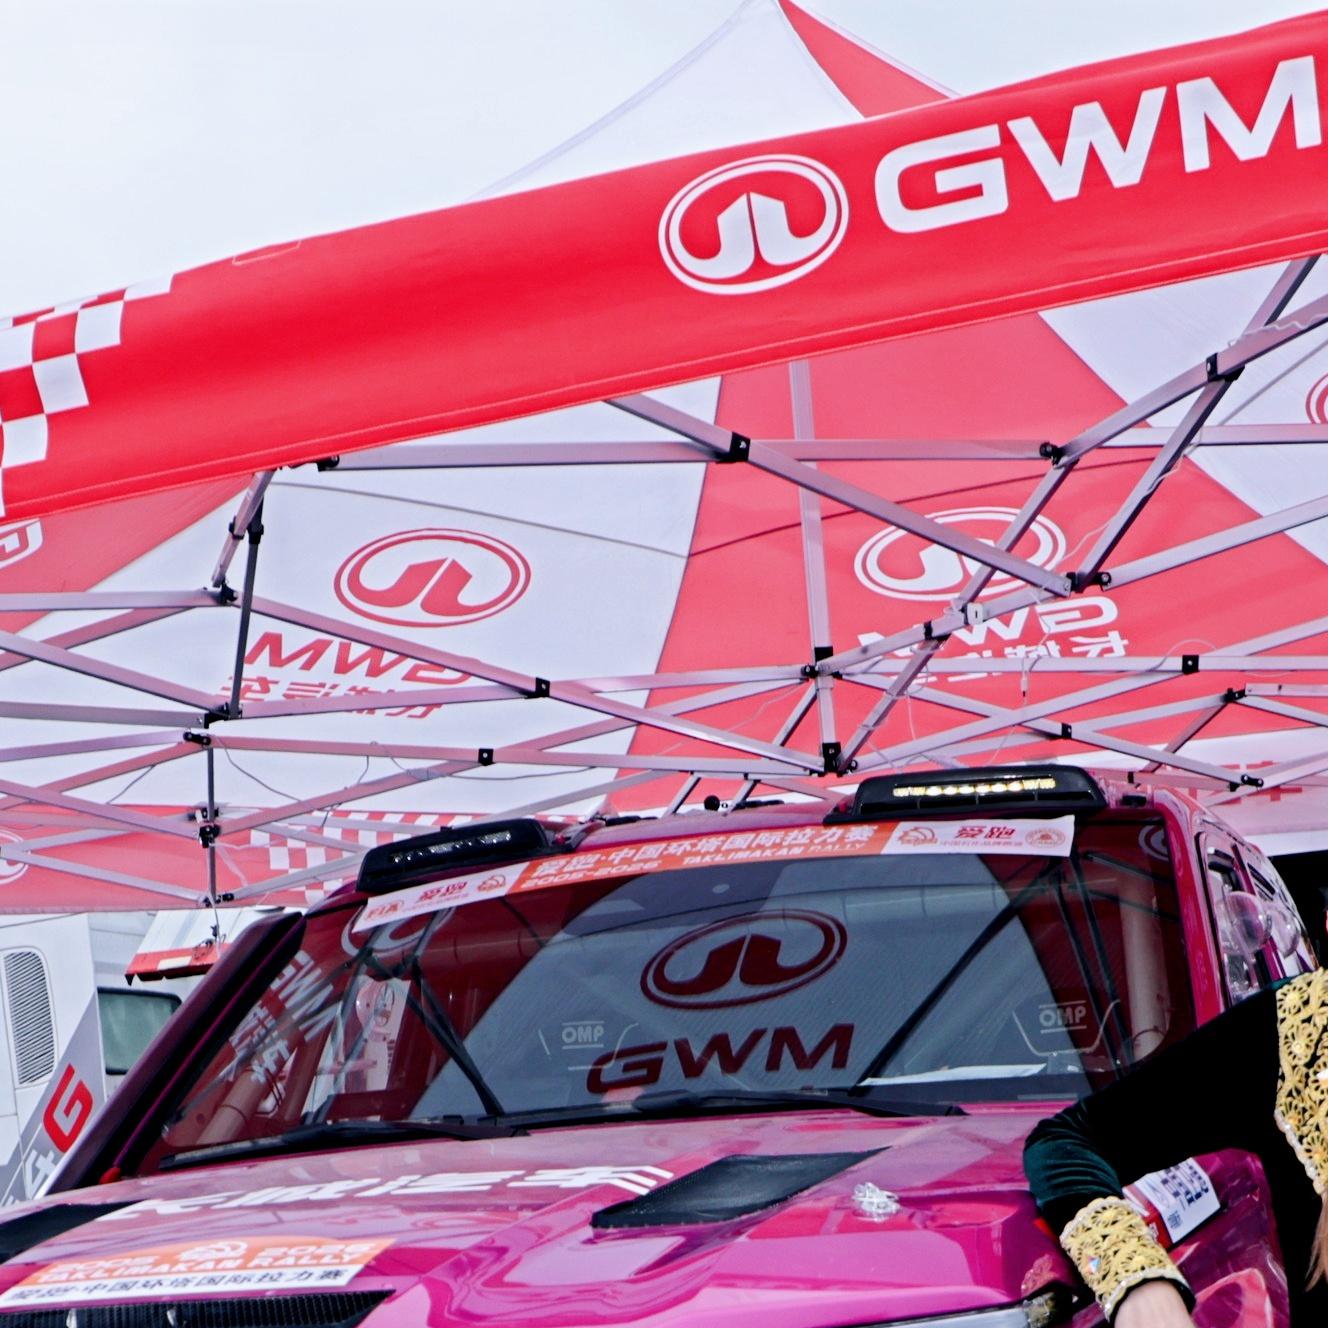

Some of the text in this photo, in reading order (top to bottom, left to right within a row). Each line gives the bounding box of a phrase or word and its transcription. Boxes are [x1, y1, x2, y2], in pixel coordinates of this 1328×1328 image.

[874, 55, 1322, 234] GWM
[683, 842, 865, 865] TAKLIMAKAN RALLY
[1038, 1003, 1087, 1026] OMP
[561, 1024, 605, 1044] OMP
[586, 1023, 855, 1095] GWM
[36, 1251, 363, 1283] TAKLIMAKAN RALLY
